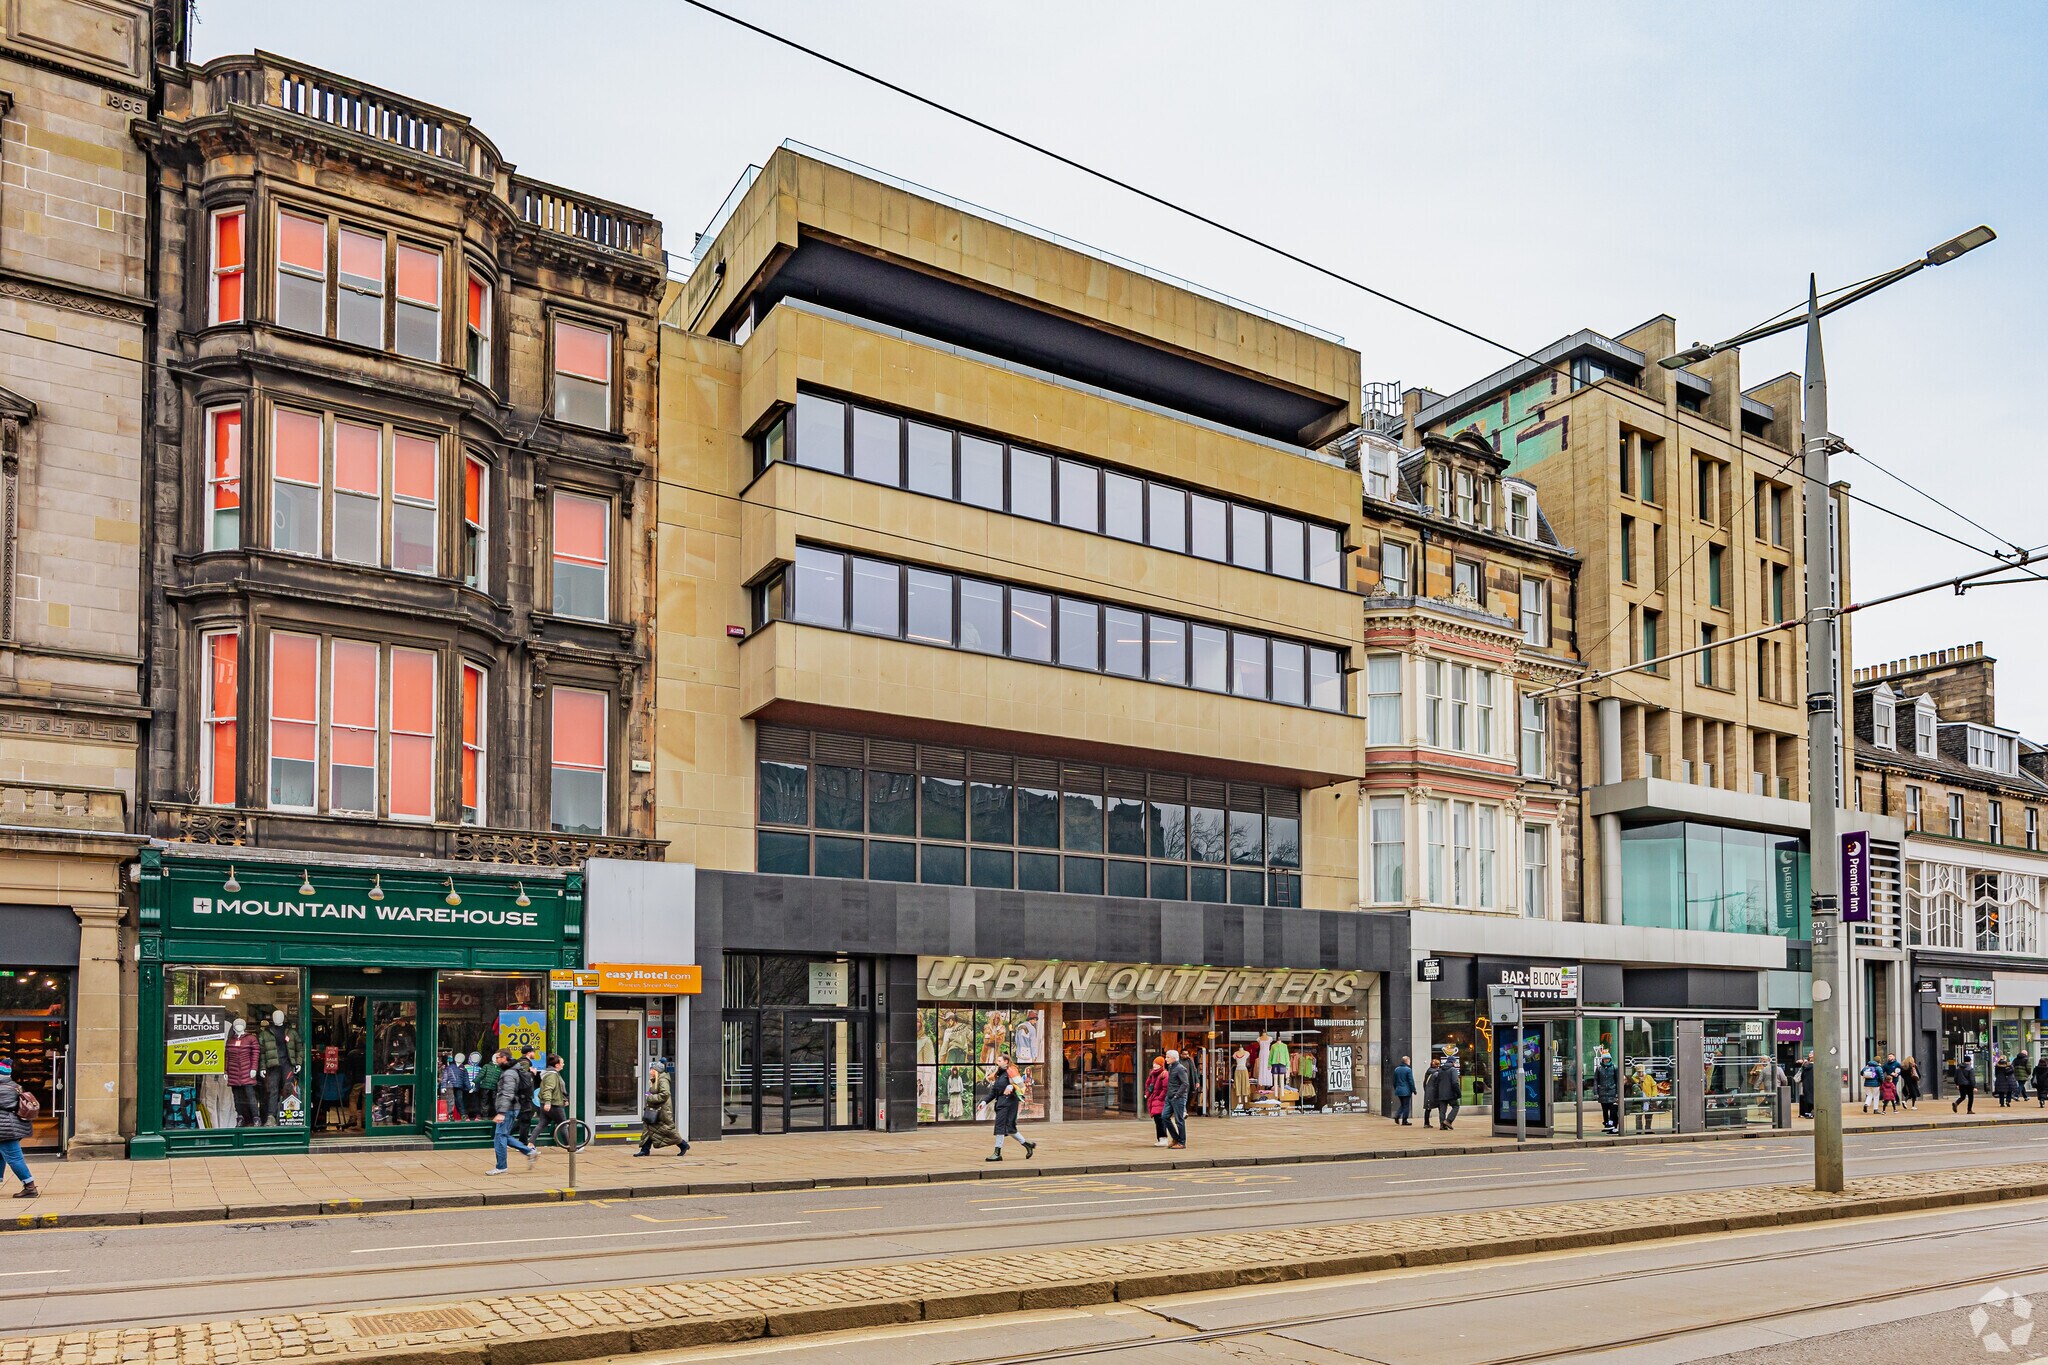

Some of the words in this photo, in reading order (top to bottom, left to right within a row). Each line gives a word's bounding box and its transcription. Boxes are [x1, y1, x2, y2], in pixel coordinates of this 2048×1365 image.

[106, 93, 142, 115] 1866
[1849, 858, 1860, 896] Premier
[217, 899, 366, 919] MOUNTAIN
[375, 906, 538, 926] WAREHOUSE
[1850, 897, 1860, 913] Inn
[605, 970, 691, 980] easyHotel.com
[926, 960, 1097, 999] URBAN
[1106, 967, 1359, 1004] OUTFITTERS
[1501, 970, 1530, 984] BAR+
[1533, 971, 1560, 986] BLOCK
[173, 1013, 220, 1025] FINAL
